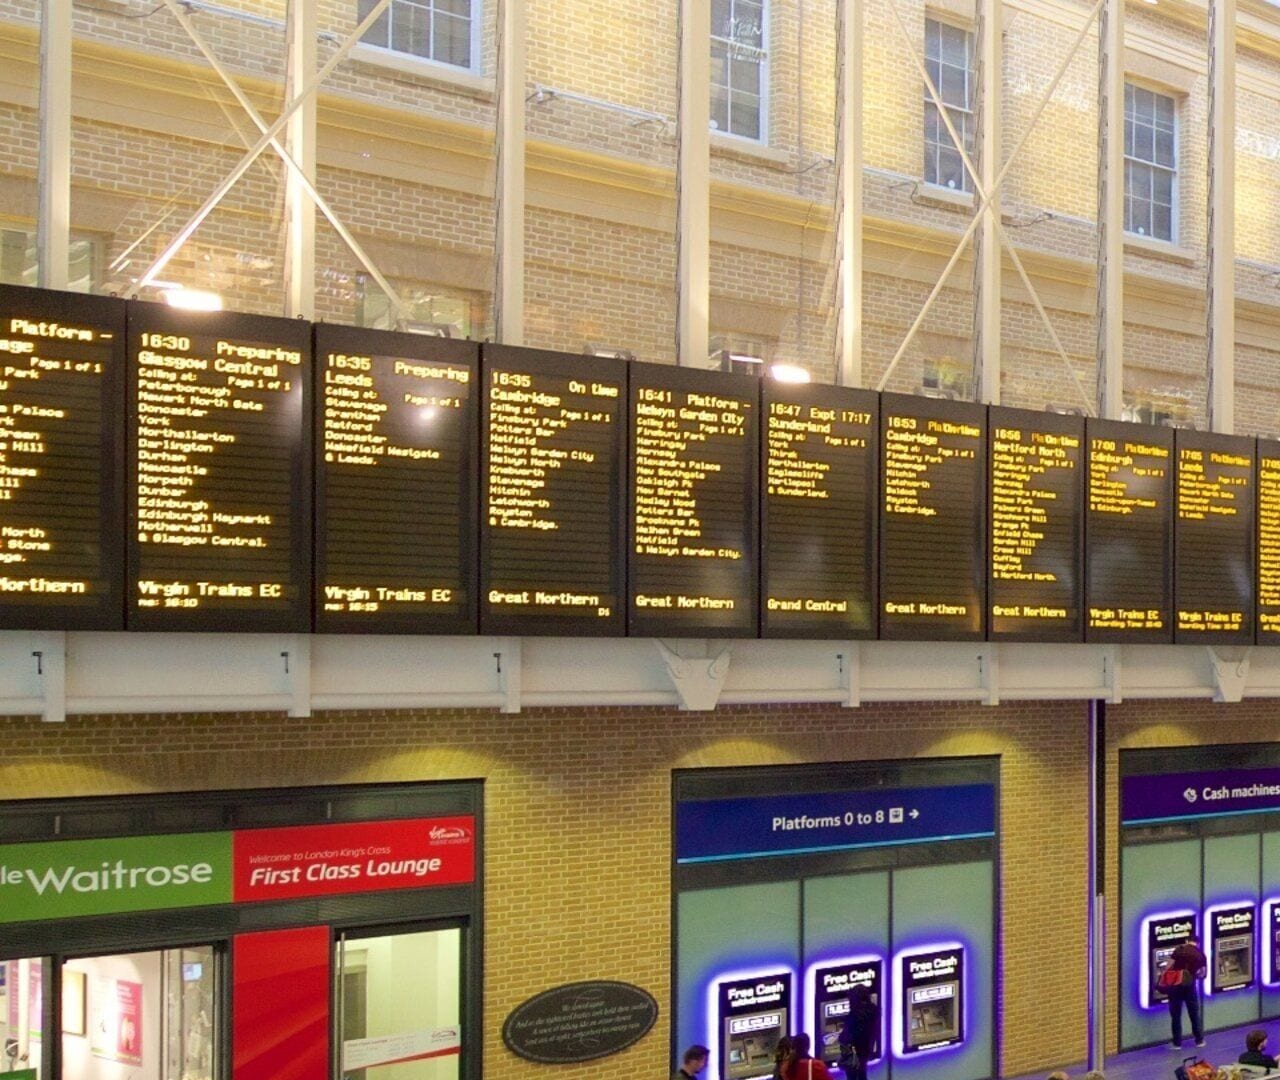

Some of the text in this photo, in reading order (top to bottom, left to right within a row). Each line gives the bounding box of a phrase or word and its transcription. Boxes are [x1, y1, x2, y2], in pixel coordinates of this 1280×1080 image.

[11, 319, 92, 341] Platform
[141, 333, 190, 350] 16:30
[216, 341, 301, 364] Preparing
[138, 351, 278, 377] Glasgow Central
[328, 354, 371, 371] 16:35
[325, 370, 373, 387] Leeds
[395, 361, 469, 383] Preparing
[493, 372, 531, 387] 16:35
[138, 379, 231, 397] Peterborough
[228, 376, 254, 389] Page
[569, 381, 618, 397] On time
[138, 391, 263, 411] Newark North Gate
[490, 388, 561, 406] Cambridge
[638, 388, 672, 402] 16:41
[687, 394, 739, 411] Platform
[138, 403, 208, 417] Doncaster
[325, 397, 387, 413] Stevenage
[770, 403, 801, 417] 16:47
[138, 415, 170, 426] York
[490, 413, 539, 427] Finsbury
[679, 409, 718, 424] Garden
[721, 414, 745, 426] City
[810, 408, 871, 424] Expt 17:17
[325, 420, 373, 432] Retford
[769, 417, 831, 434] Sunderland
[138, 427, 235, 443] Northallerton
[325, 431, 387, 444] Doncaster
[886, 431, 938, 445] Cambridge
[138, 438, 213, 453] Darlington
[1039, 446, 1066, 458] North
[1090, 451, 1133, 466] Edinburgh
[138, 462, 207, 476] Newcastle
[138, 474, 193, 486] Morpeth
[138, 485, 187, 497] Dunbar
[138, 497, 208, 511] Edinburgh
[138, 509, 208, 523] Edinburgh
[2, 526, 45, 538] North
[138, 521, 213, 533] Motherwell
[153, 534, 207, 546] Glasgow
[138, 580, 281, 597] Virgin Trains EC
[325, 586, 451, 602] Virgin Trains EC
[488, 590, 599, 606] Great Northern
[636, 595, 734, 610] Great Northern
[768, 599, 847, 612] Grand Central
[886, 602, 966, 616] Great Northern
[1203, 784, 1280, 801] Cash machines
[772, 809, 884, 832] Platforms 0 to 8
[249, 853, 292, 864] Welcome
[304, 850, 338, 860] London
[367, 846, 391, 856] Cross
[26, 860, 213, 896] Waitrose
[249, 857, 441, 887] First Class Lounge
[910, 956, 957, 973] Free Cash
[824, 969, 875, 986] Free Cash
[728, 987, 753, 1000] Free
[756, 982, 784, 995] Cash
